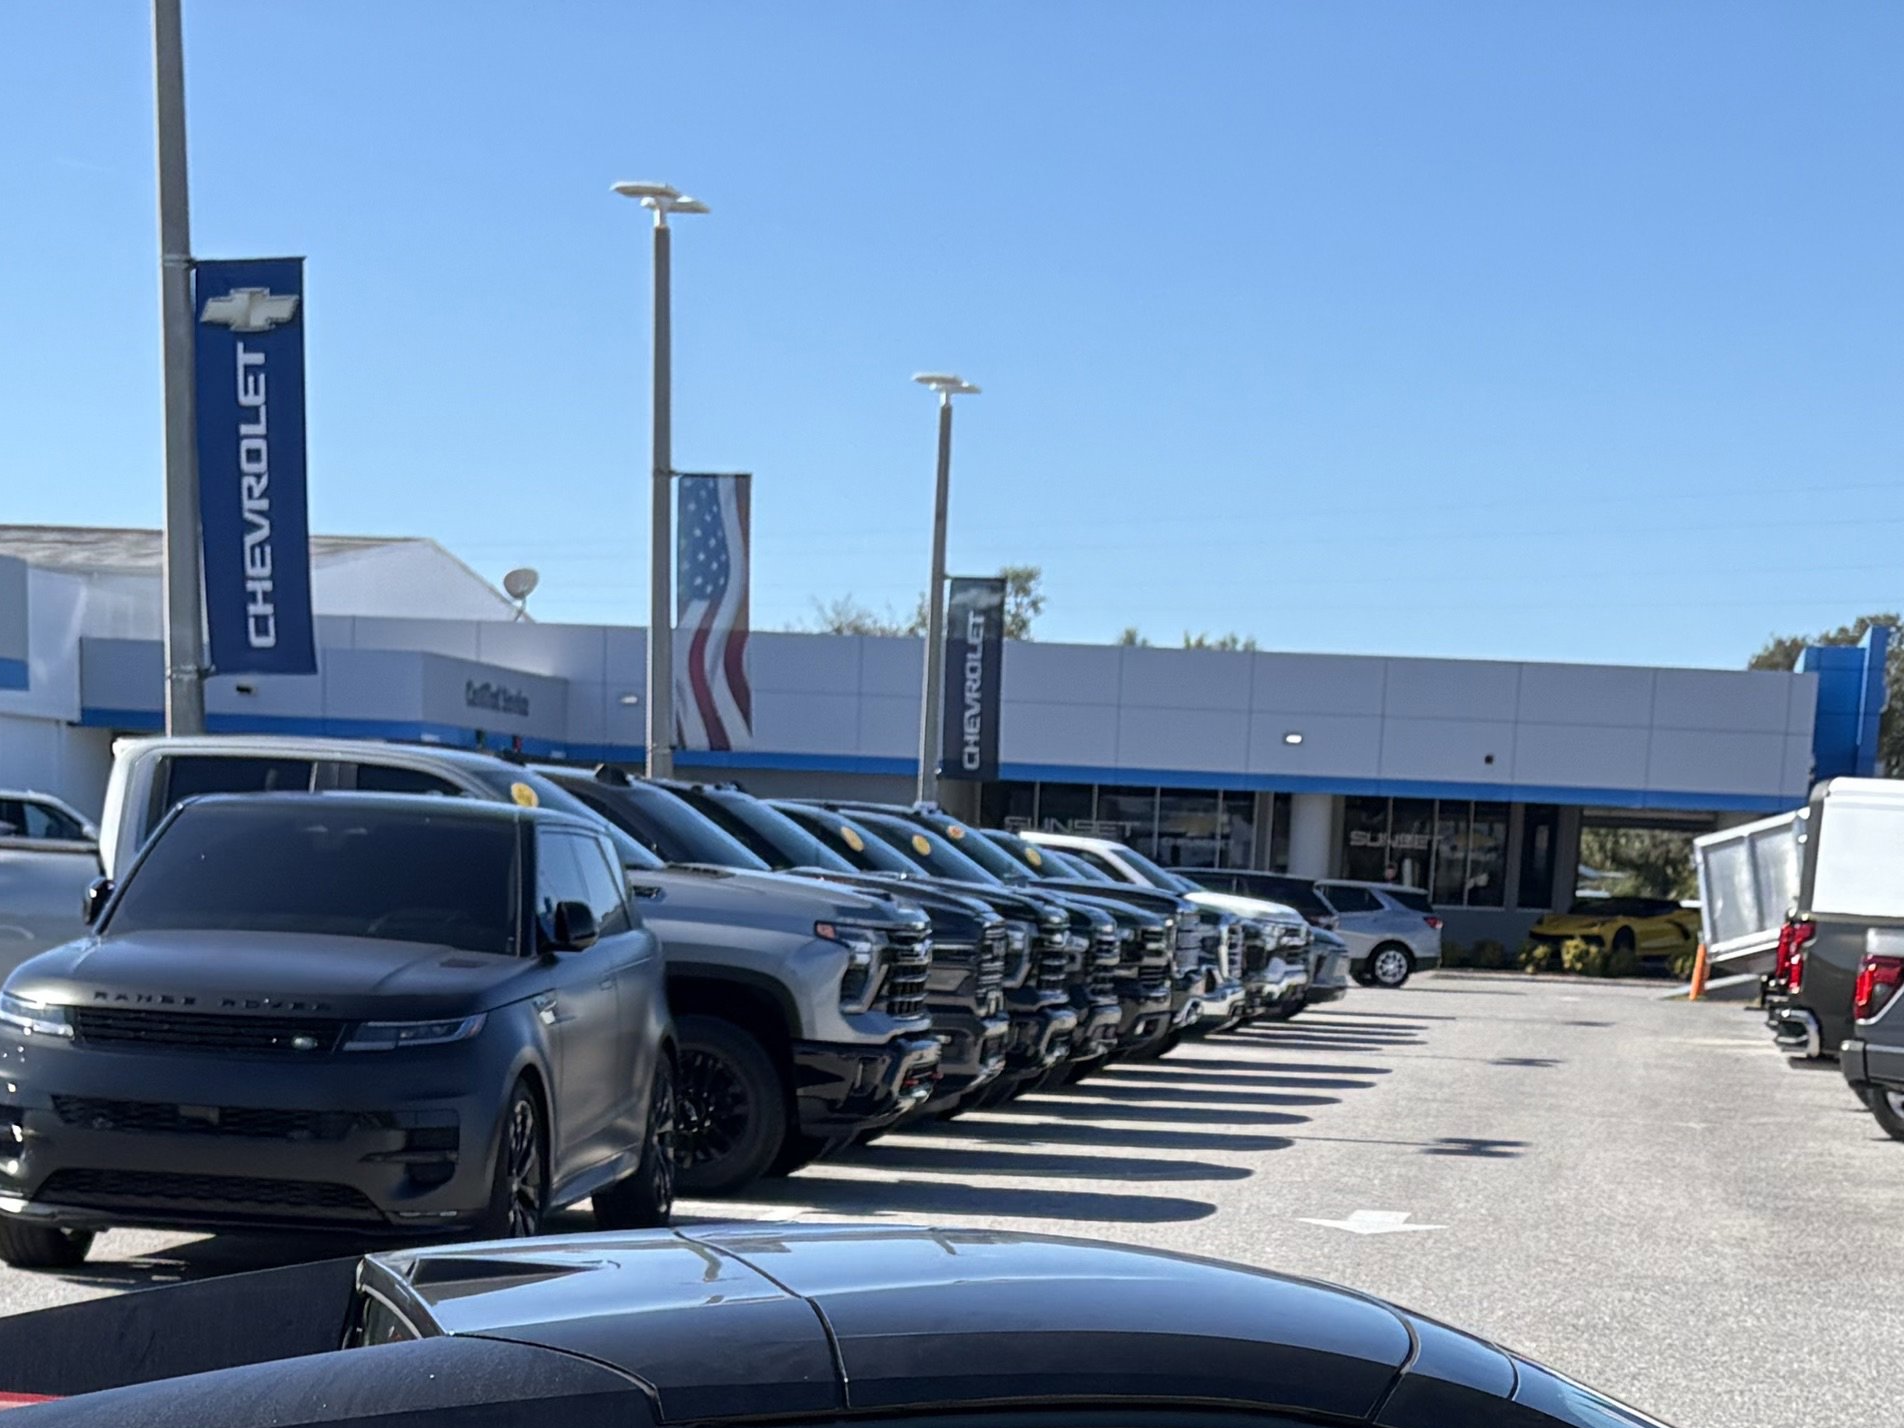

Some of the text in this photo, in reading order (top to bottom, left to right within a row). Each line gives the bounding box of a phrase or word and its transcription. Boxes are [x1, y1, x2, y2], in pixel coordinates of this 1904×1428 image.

[235, 340, 278, 650] CHEVROLET
[961, 610, 985, 772] CHEVROLET
[94, 990, 197, 1006] RANGE
